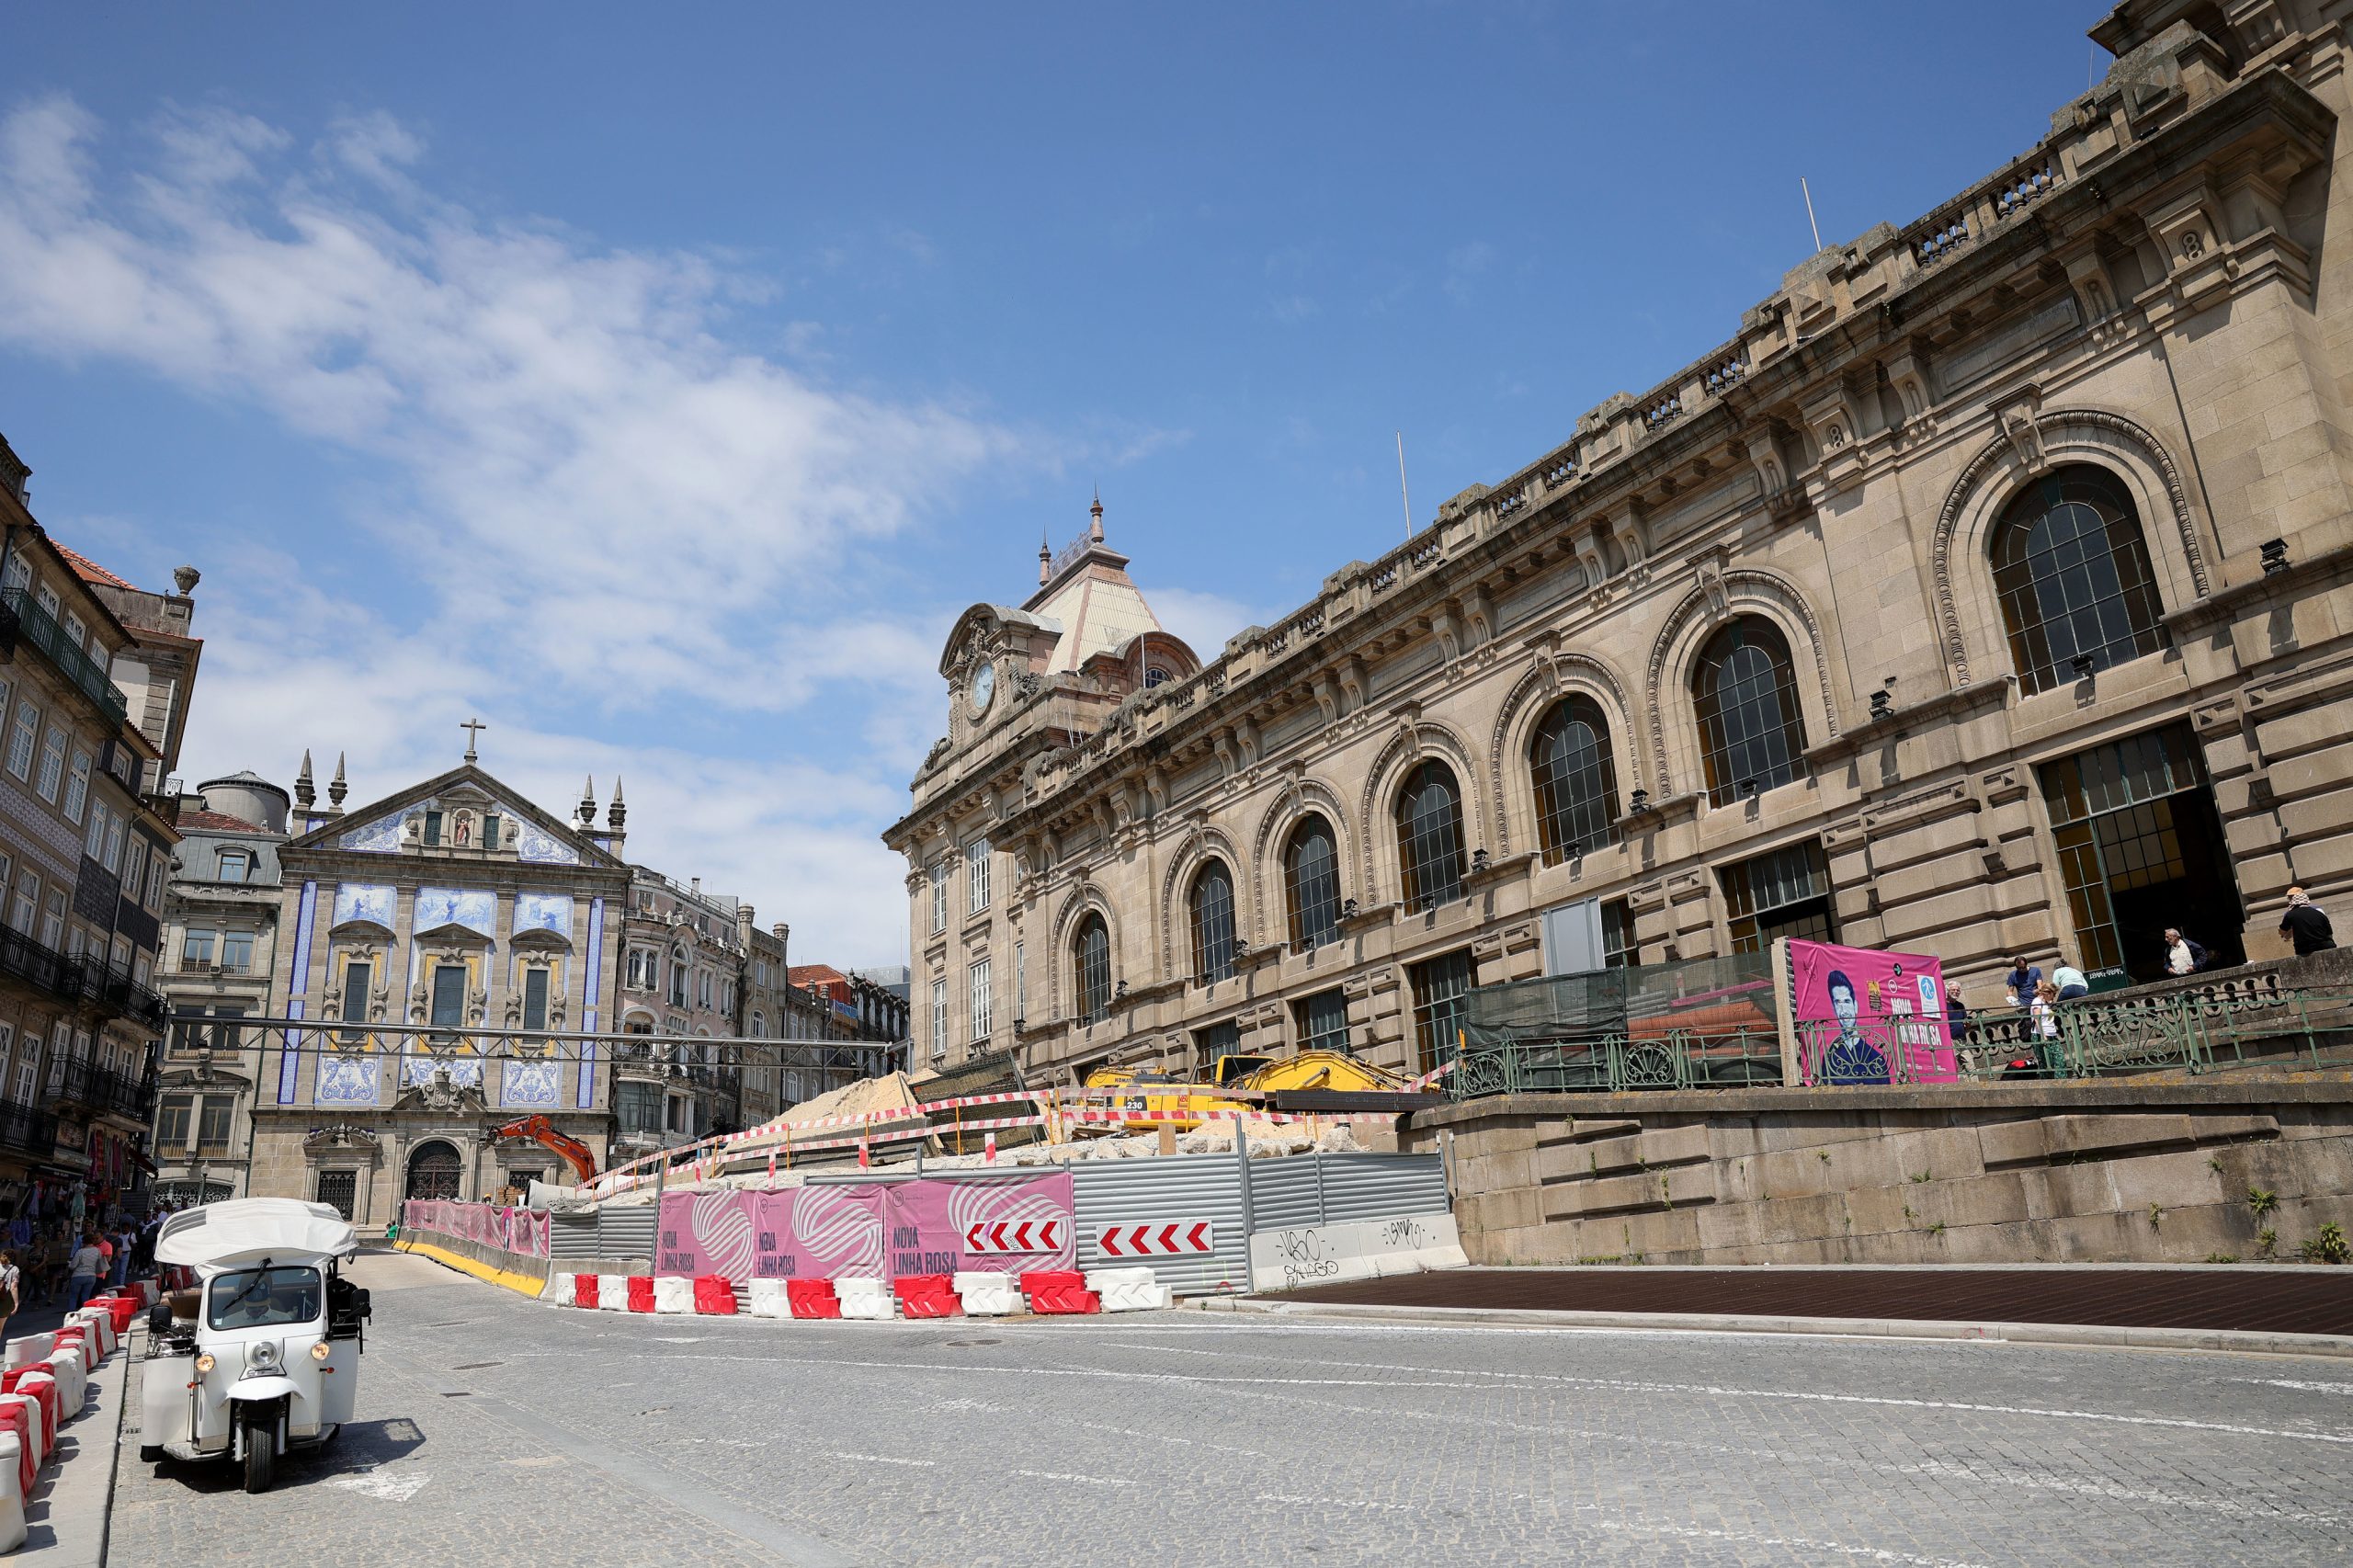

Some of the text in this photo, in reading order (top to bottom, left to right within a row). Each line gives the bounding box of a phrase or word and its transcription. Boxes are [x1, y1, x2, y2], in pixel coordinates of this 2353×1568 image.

[1891, 997, 1914, 1018] NOVA
[1898, 1024, 1920, 1044] INHA
[1126, 1101, 1142, 1109] 230
[662, 1231, 677, 1249] NOVA
[758, 1232, 777, 1253] NOVA
[893, 1226, 919, 1249] NOVA
[661, 1252, 695, 1273] LINHA ROSA
[757, 1255, 796, 1277] LINHA ROSA
[892, 1251, 959, 1275] LINHA ROSA
